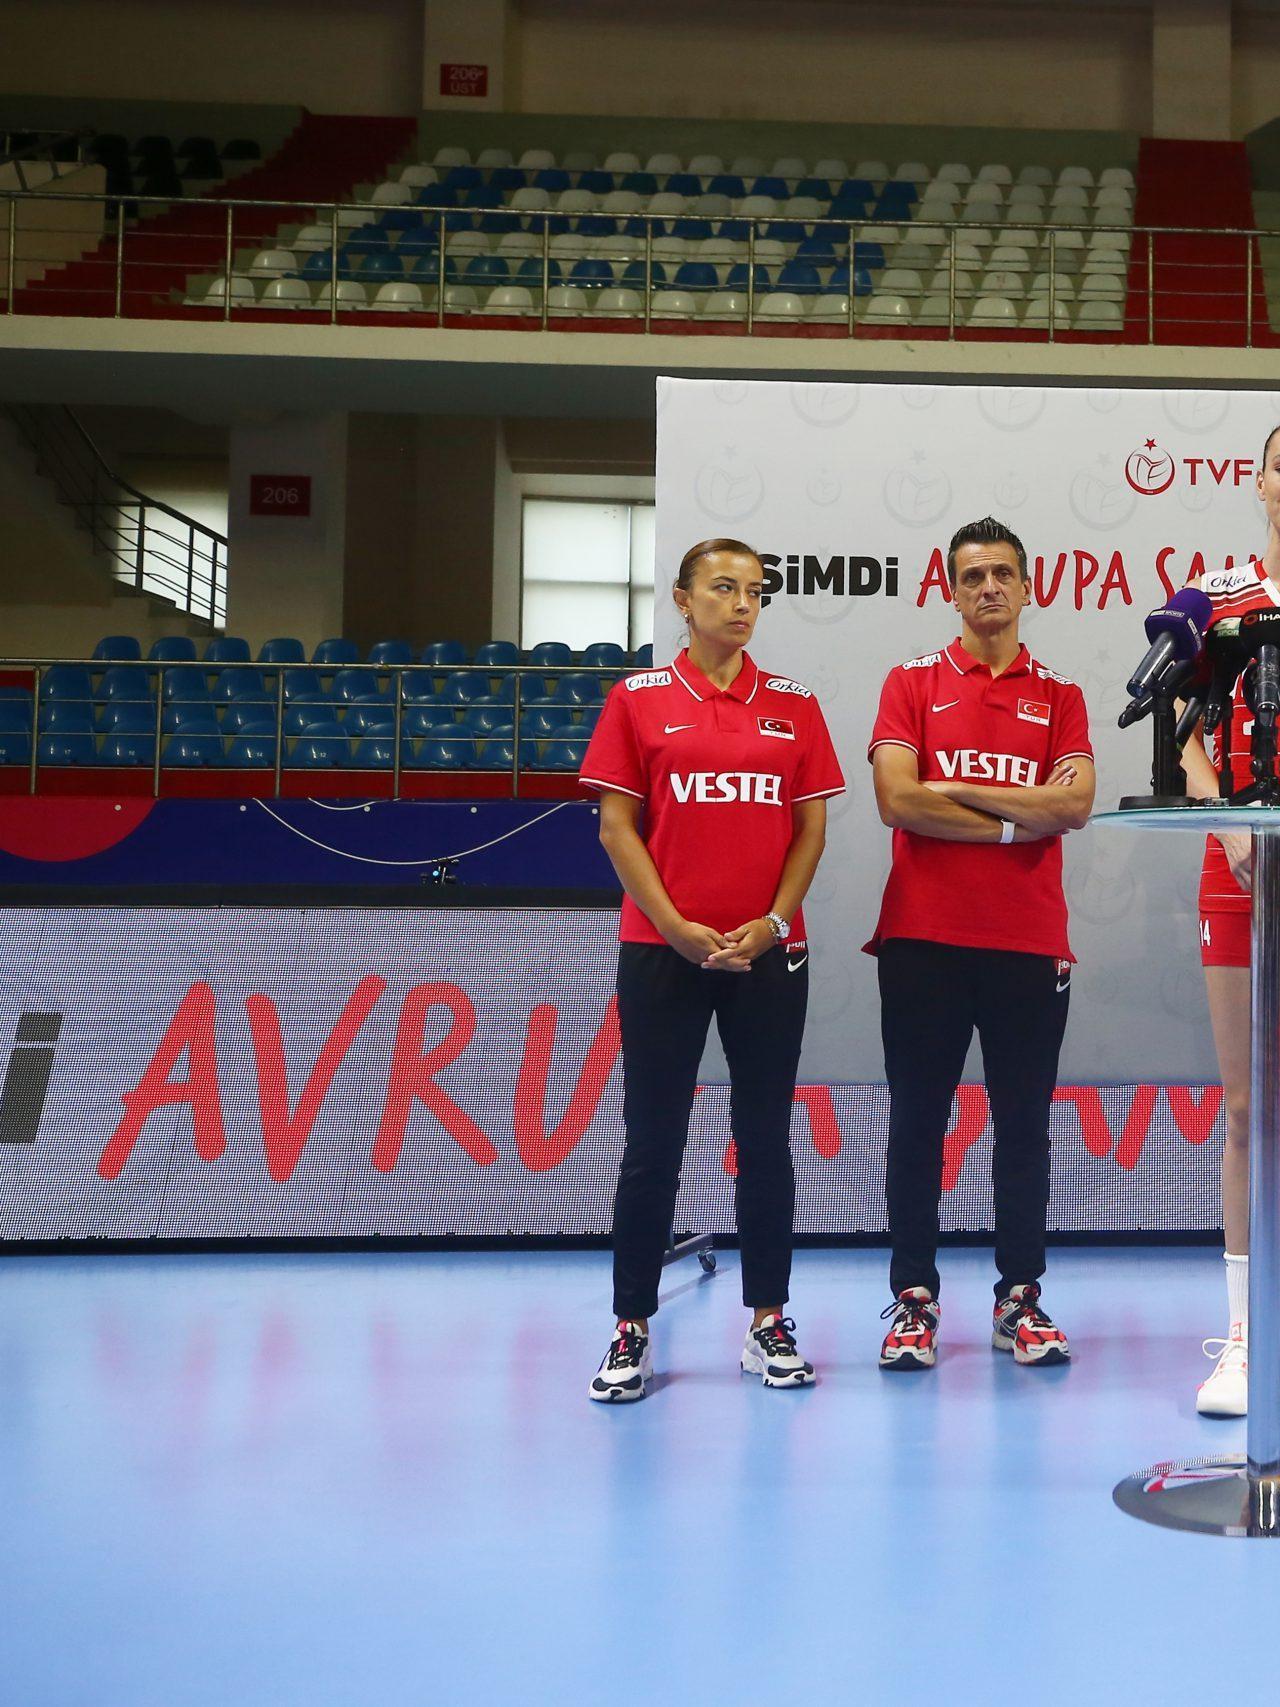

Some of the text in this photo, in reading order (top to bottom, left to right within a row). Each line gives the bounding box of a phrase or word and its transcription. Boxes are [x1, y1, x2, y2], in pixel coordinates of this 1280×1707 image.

[1183, 458, 1254, 486] TVF
[262, 487, 299, 504] 206
[916, 547, 1132, 611] AUPA
[628, 672, 669, 690] Orkid
[767, 679, 810, 697] Orkid
[936, 750, 1038, 787] VESTEL
[670, 772, 783, 806] VESTEL
